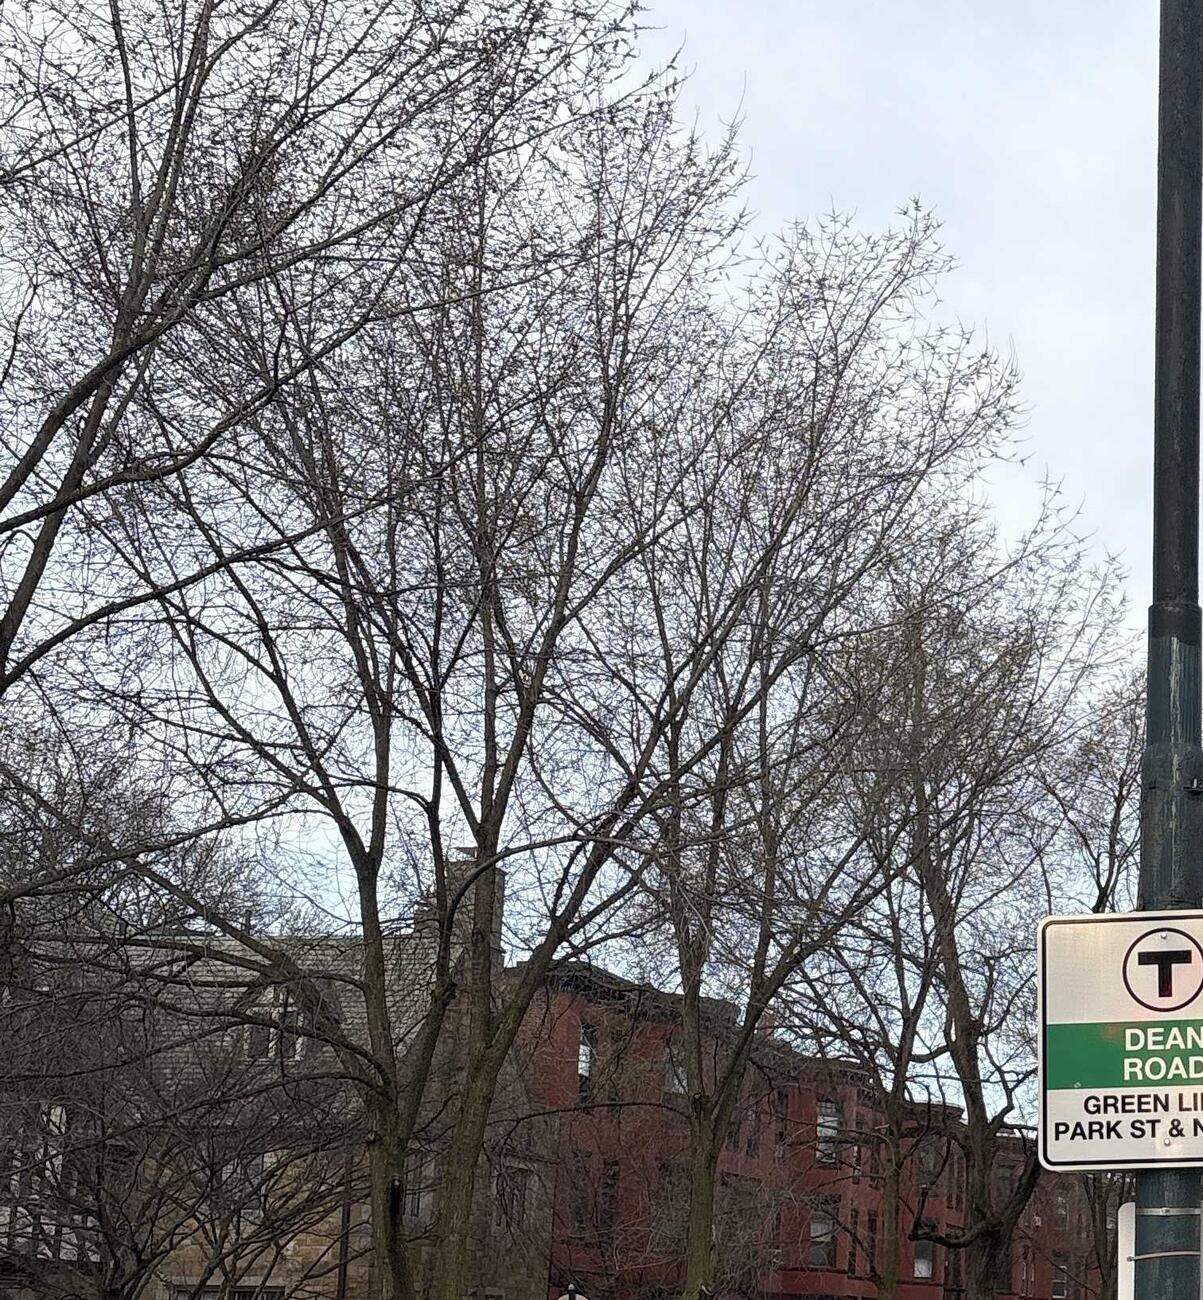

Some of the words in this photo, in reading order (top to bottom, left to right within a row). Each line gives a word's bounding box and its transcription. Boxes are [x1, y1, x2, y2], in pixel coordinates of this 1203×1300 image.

[1138, 950, 1192, 997] T
[1083, 1093, 1170, 1115] GREEN
[1054, 1120, 1123, 1141] PARK
[1130, 1119, 1161, 1139] ST
[1168, 1118, 1186, 1137] &
